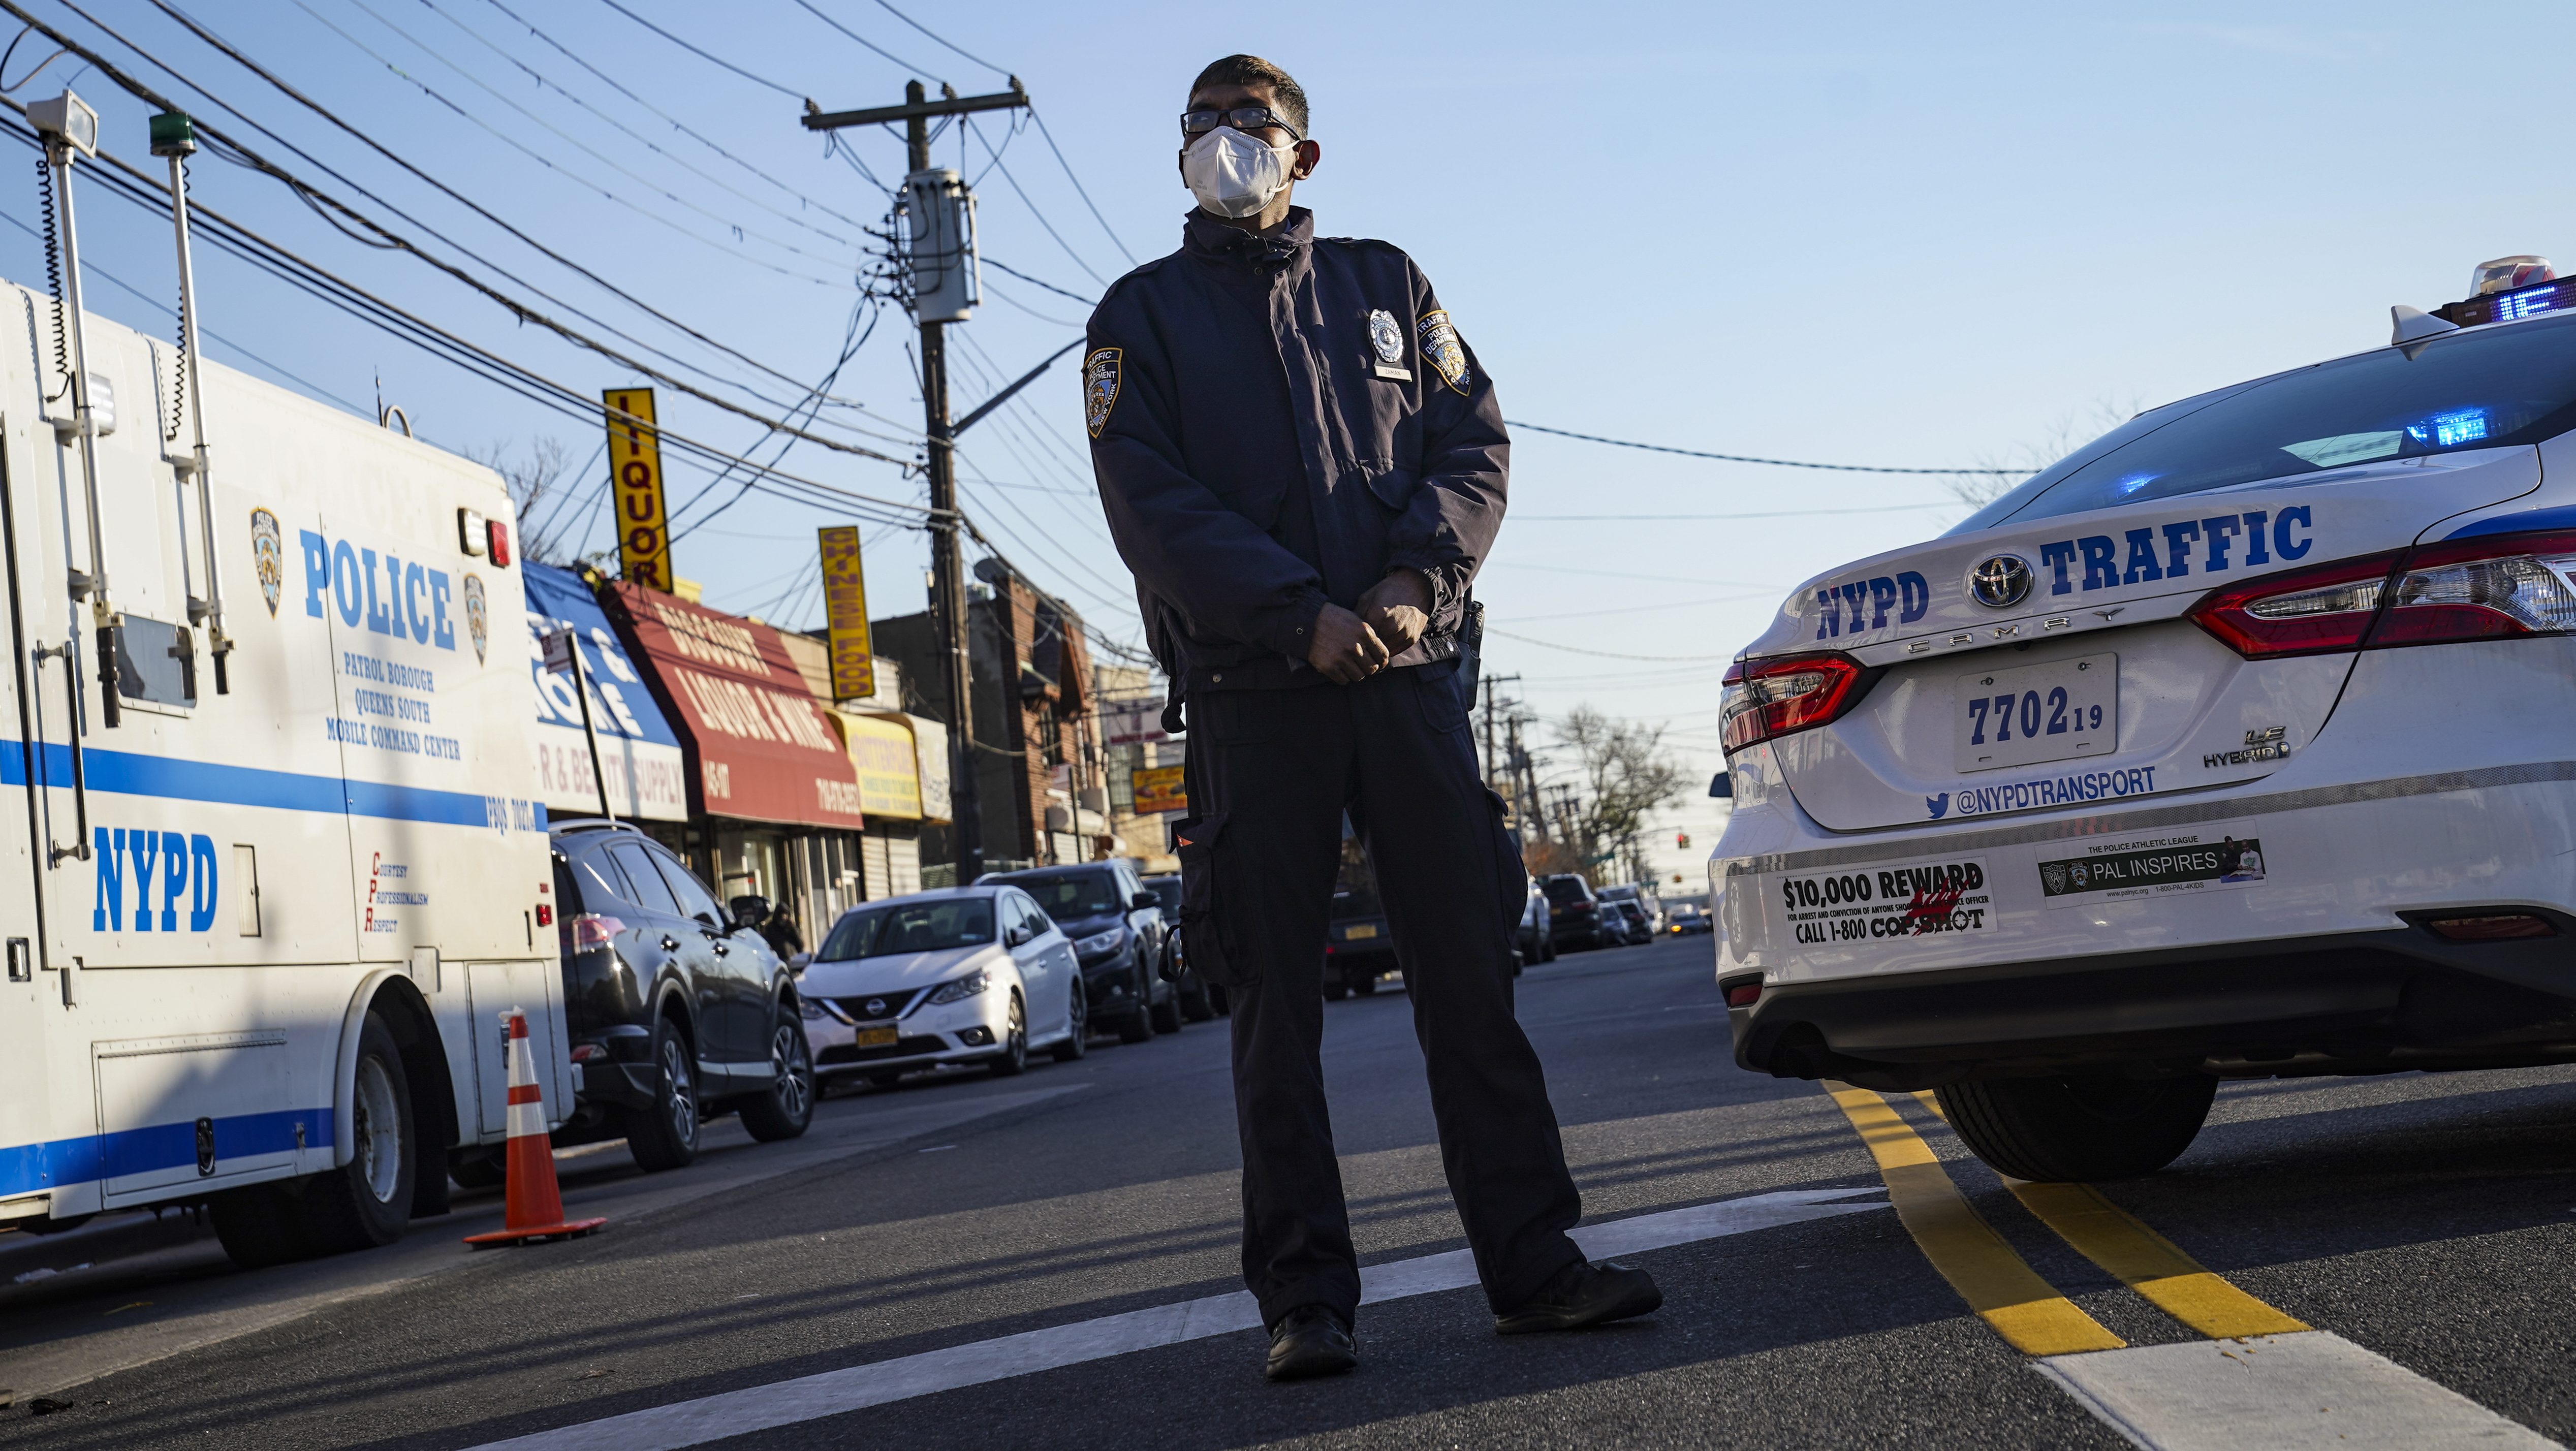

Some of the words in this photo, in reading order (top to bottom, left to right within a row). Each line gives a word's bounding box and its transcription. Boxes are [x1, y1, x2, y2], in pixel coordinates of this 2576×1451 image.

[1427, 326, 1450, 341] POLICE
[1087, 351, 1112, 371] TRAFFIC
[1098, 407, 1108, 426] NEW
[1105, 383, 1117, 405] YORK
[618, 395, 661, 588] LIQUOR
[2039, 505, 2313, 596] TRAFFIC
[299, 528, 455, 651] POLICE
[1816, 571, 1930, 641] NYPD
[1907, 607, 2125, 654] CAMRY
[344, 651, 385, 682] PATROL
[387, 661, 434, 692] BOROUGH
[833, 636, 871, 695] FOOD
[356, 687, 394, 717] QUEENS
[398, 696, 431, 724] SOUTH
[674, 667, 777, 742] LIQUOR
[755, 686, 793, 744] &
[768, 690, 837, 753] WINE
[1968, 686, 2068, 746] 7702
[2074, 704, 2103, 732] 19
[326, 717, 368, 746] MOBILE
[371, 725, 420, 755] COMMAND
[424, 735, 461, 761] CENTER
[2204, 745, 2276, 769] HYBRID
[2243, 726, 2286, 745] LE
[556, 746, 569, 793] &
[633, 757, 682, 804] SUPPLY
[1957, 766, 2155, 814] @NYPDTRANSPORT
[2088, 845, 2102, 854] THE
[2104, 842, 2130, 852] POLICE
[2131, 838, 2167, 849] ATHLETIC
[2168, 835, 2199, 845] LEAGUE
[2092, 862, 2127, 880] PAL
[2130, 851, 2218, 877] INSPIRES
[93, 827, 217, 932] NYPD
[1783, 873, 1872, 911] $10,000
[1877, 863, 1984, 899] REWARD
[2049, 871, 2061, 884] PAL
[2107, 888, 2149, 897] www.palnyc.org
[2155, 881, 2205, 893] 1-800-PAL-4KIDS
[364, 907, 398, 933] RESPECT
[1796, 922, 1827, 944] CALL
[1829, 918, 1867, 941] 1-800
[1870, 907, 1985, 938] COP-SHOT
[1799, 912, 1816, 921] ARREST
[1818, 911, 1829, 919] AND
[1830, 908, 1862, 918] CONVICTION
[1871, 904, 1895, 914] ANYONE
[1965, 895, 1990, 905] OFFICER
